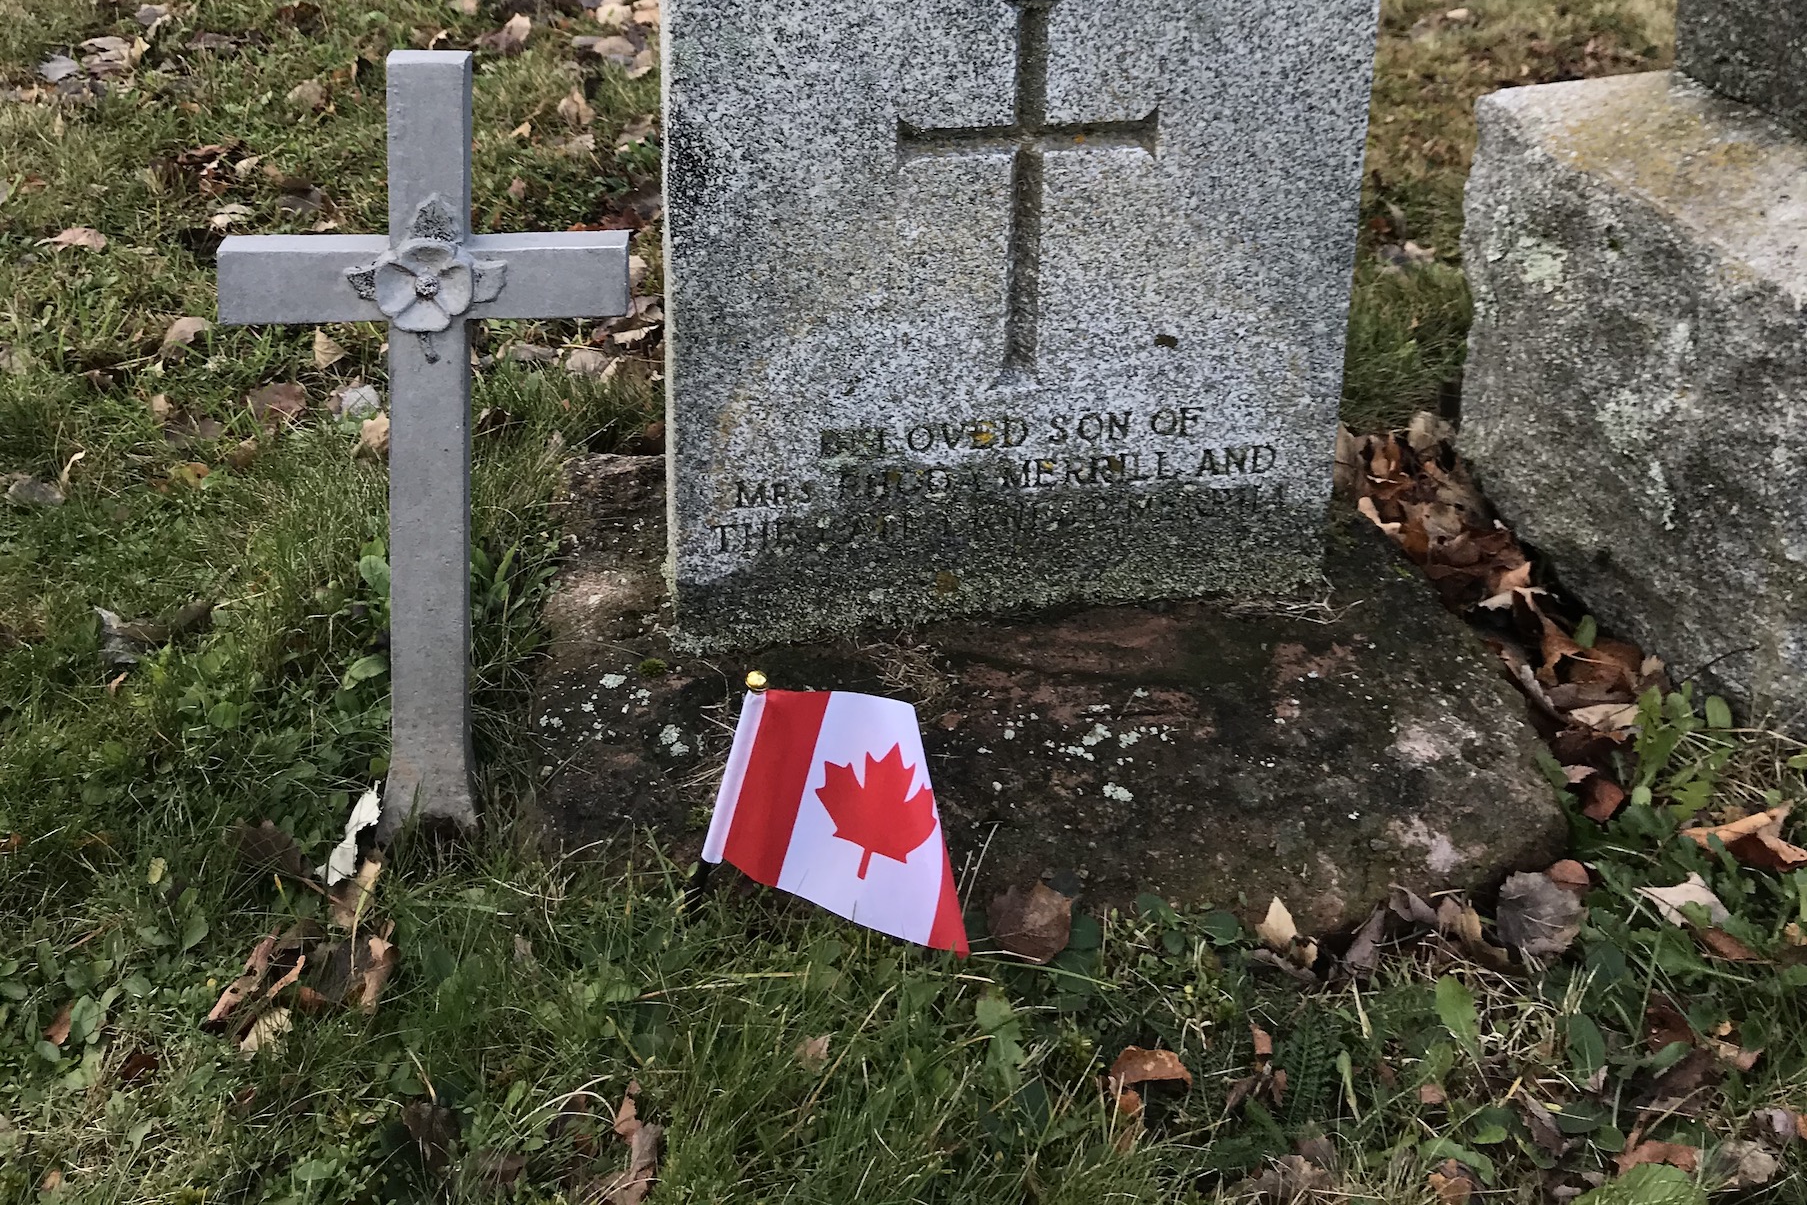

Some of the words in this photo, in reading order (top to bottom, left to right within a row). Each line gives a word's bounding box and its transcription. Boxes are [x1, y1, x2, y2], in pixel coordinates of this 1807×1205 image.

[818, 415, 1030, 460] BLOVED
[1048, 408, 1132, 449] SON
[1150, 405, 1205, 439] OF
[994, 449, 1180, 490] MERRILL
[1195, 444, 1278, 480] AND
